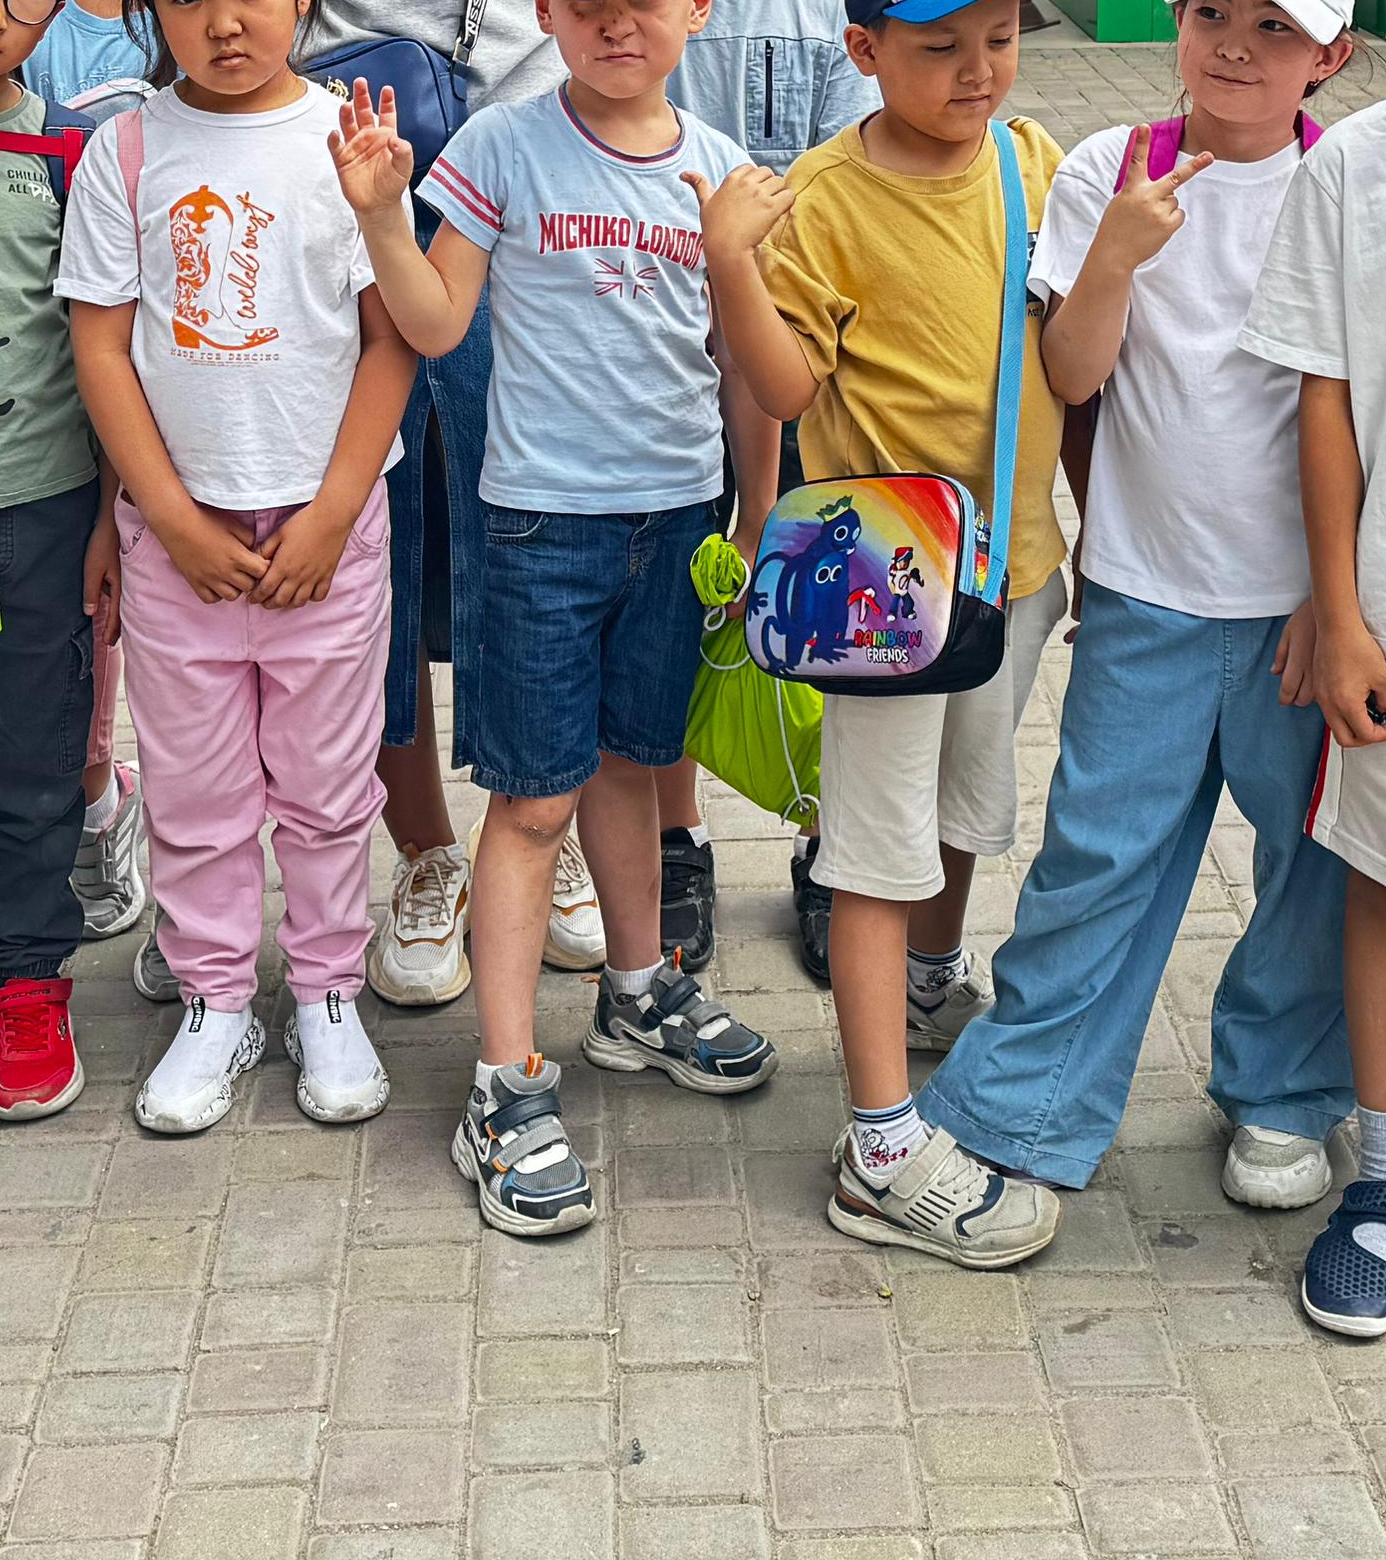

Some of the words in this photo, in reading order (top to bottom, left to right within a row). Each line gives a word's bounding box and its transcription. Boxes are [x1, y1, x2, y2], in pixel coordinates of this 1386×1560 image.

[9, 184, 28, 194] ALL
[539, 213, 631, 254] MICHIKO
[854, 629, 922, 648] RAINBOW
[866, 648, 909, 664] FRIENDS
